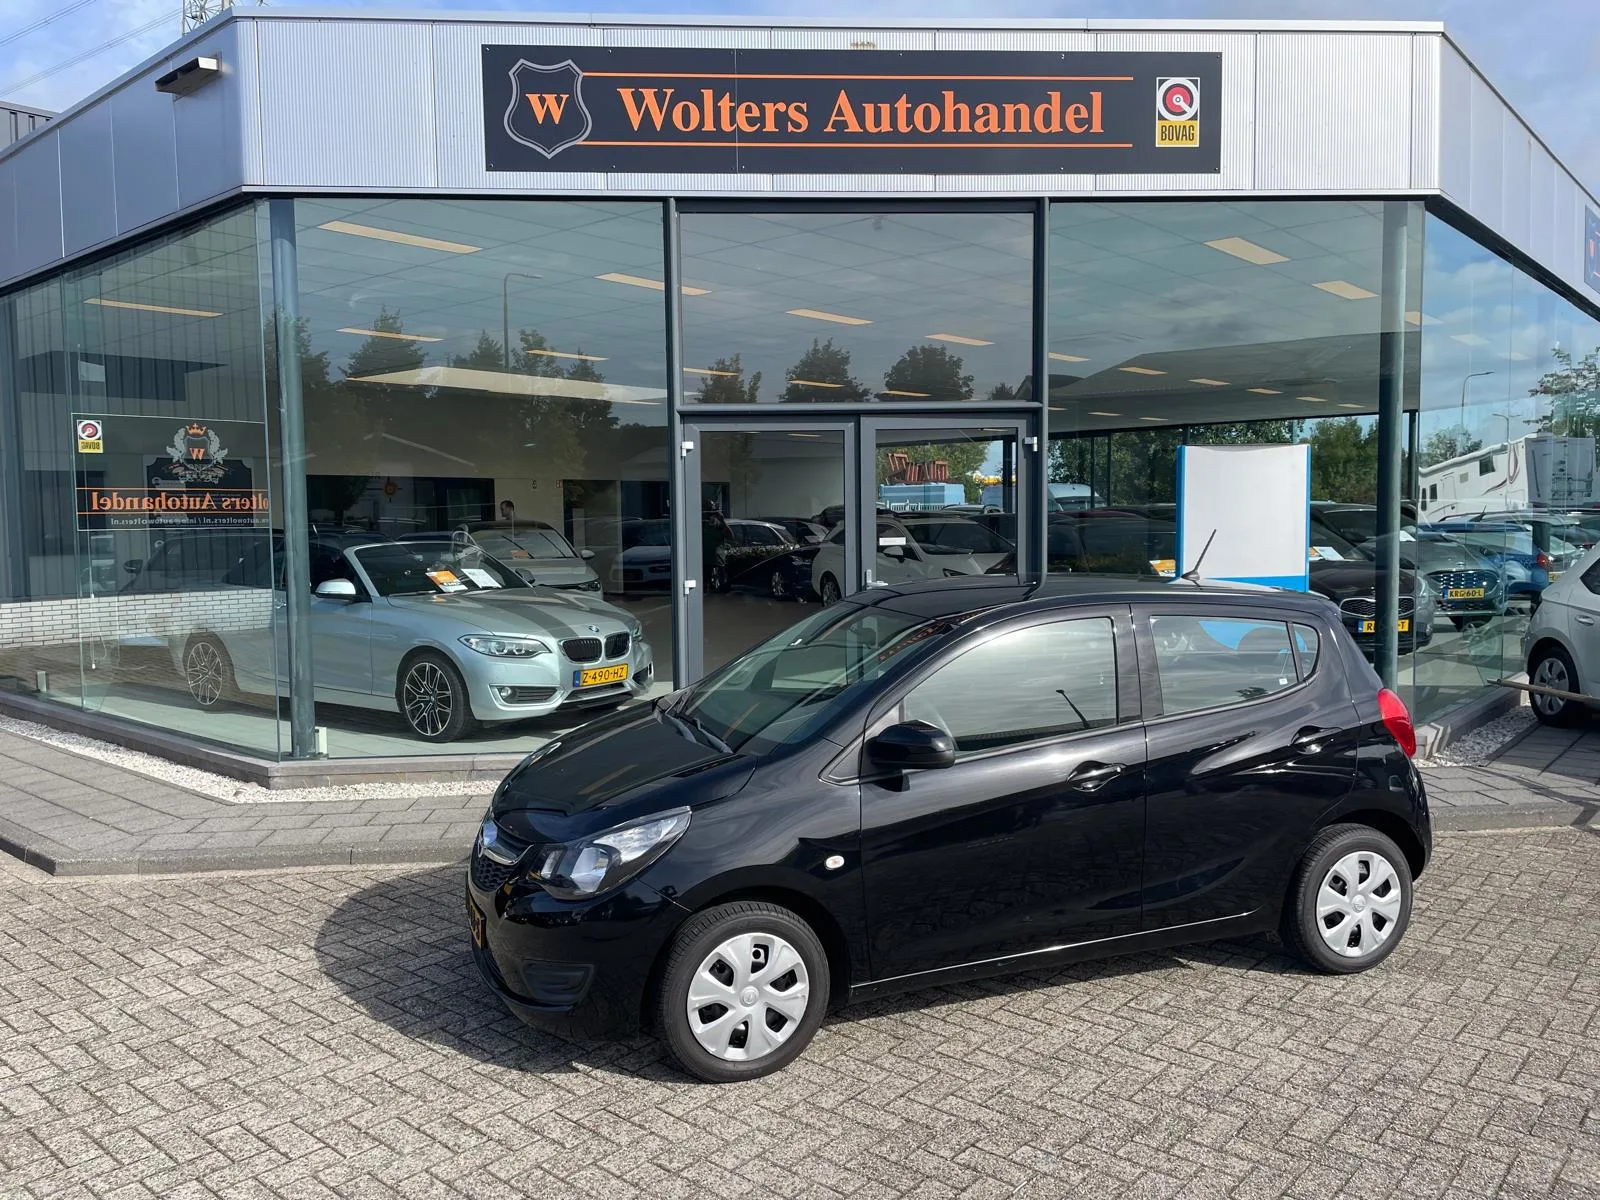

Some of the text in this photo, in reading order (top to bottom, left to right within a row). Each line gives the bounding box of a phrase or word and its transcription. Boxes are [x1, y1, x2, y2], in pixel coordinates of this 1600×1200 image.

[526, 93, 569, 124] W
[617, 87, 1104, 134] Wolters Autohandel
[1160, 123, 1196, 142] BOVAG
[582, 667, 625, 684] Z-490-HZ
